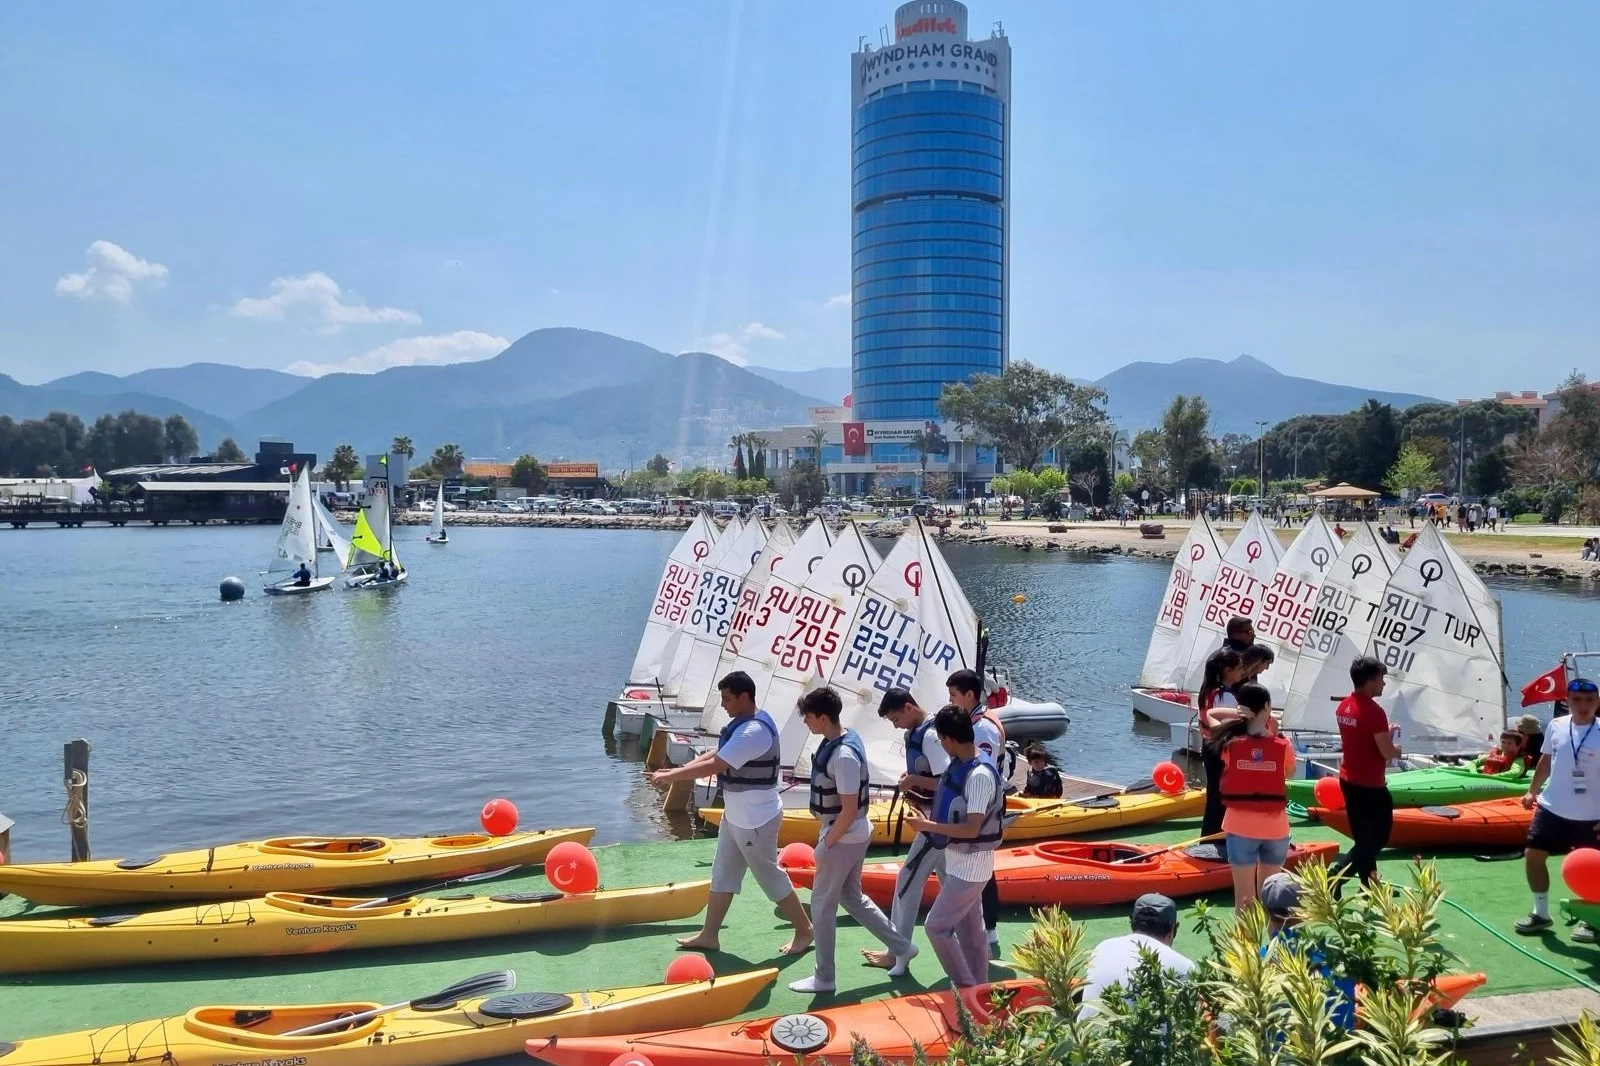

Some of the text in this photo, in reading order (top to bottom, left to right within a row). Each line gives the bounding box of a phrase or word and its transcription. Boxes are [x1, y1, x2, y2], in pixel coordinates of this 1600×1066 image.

[866, 43, 998, 72] WYNDHAM GRAND
[1311, 606, 1348, 636] 1182
[1377, 616, 1426, 647] 1187
[1445, 612, 1481, 648] TUR
[789, 619, 840, 654] 705
[286, 923, 357, 936] Venture Kayaks
[262, 1056, 307, 1066] Kayaks
